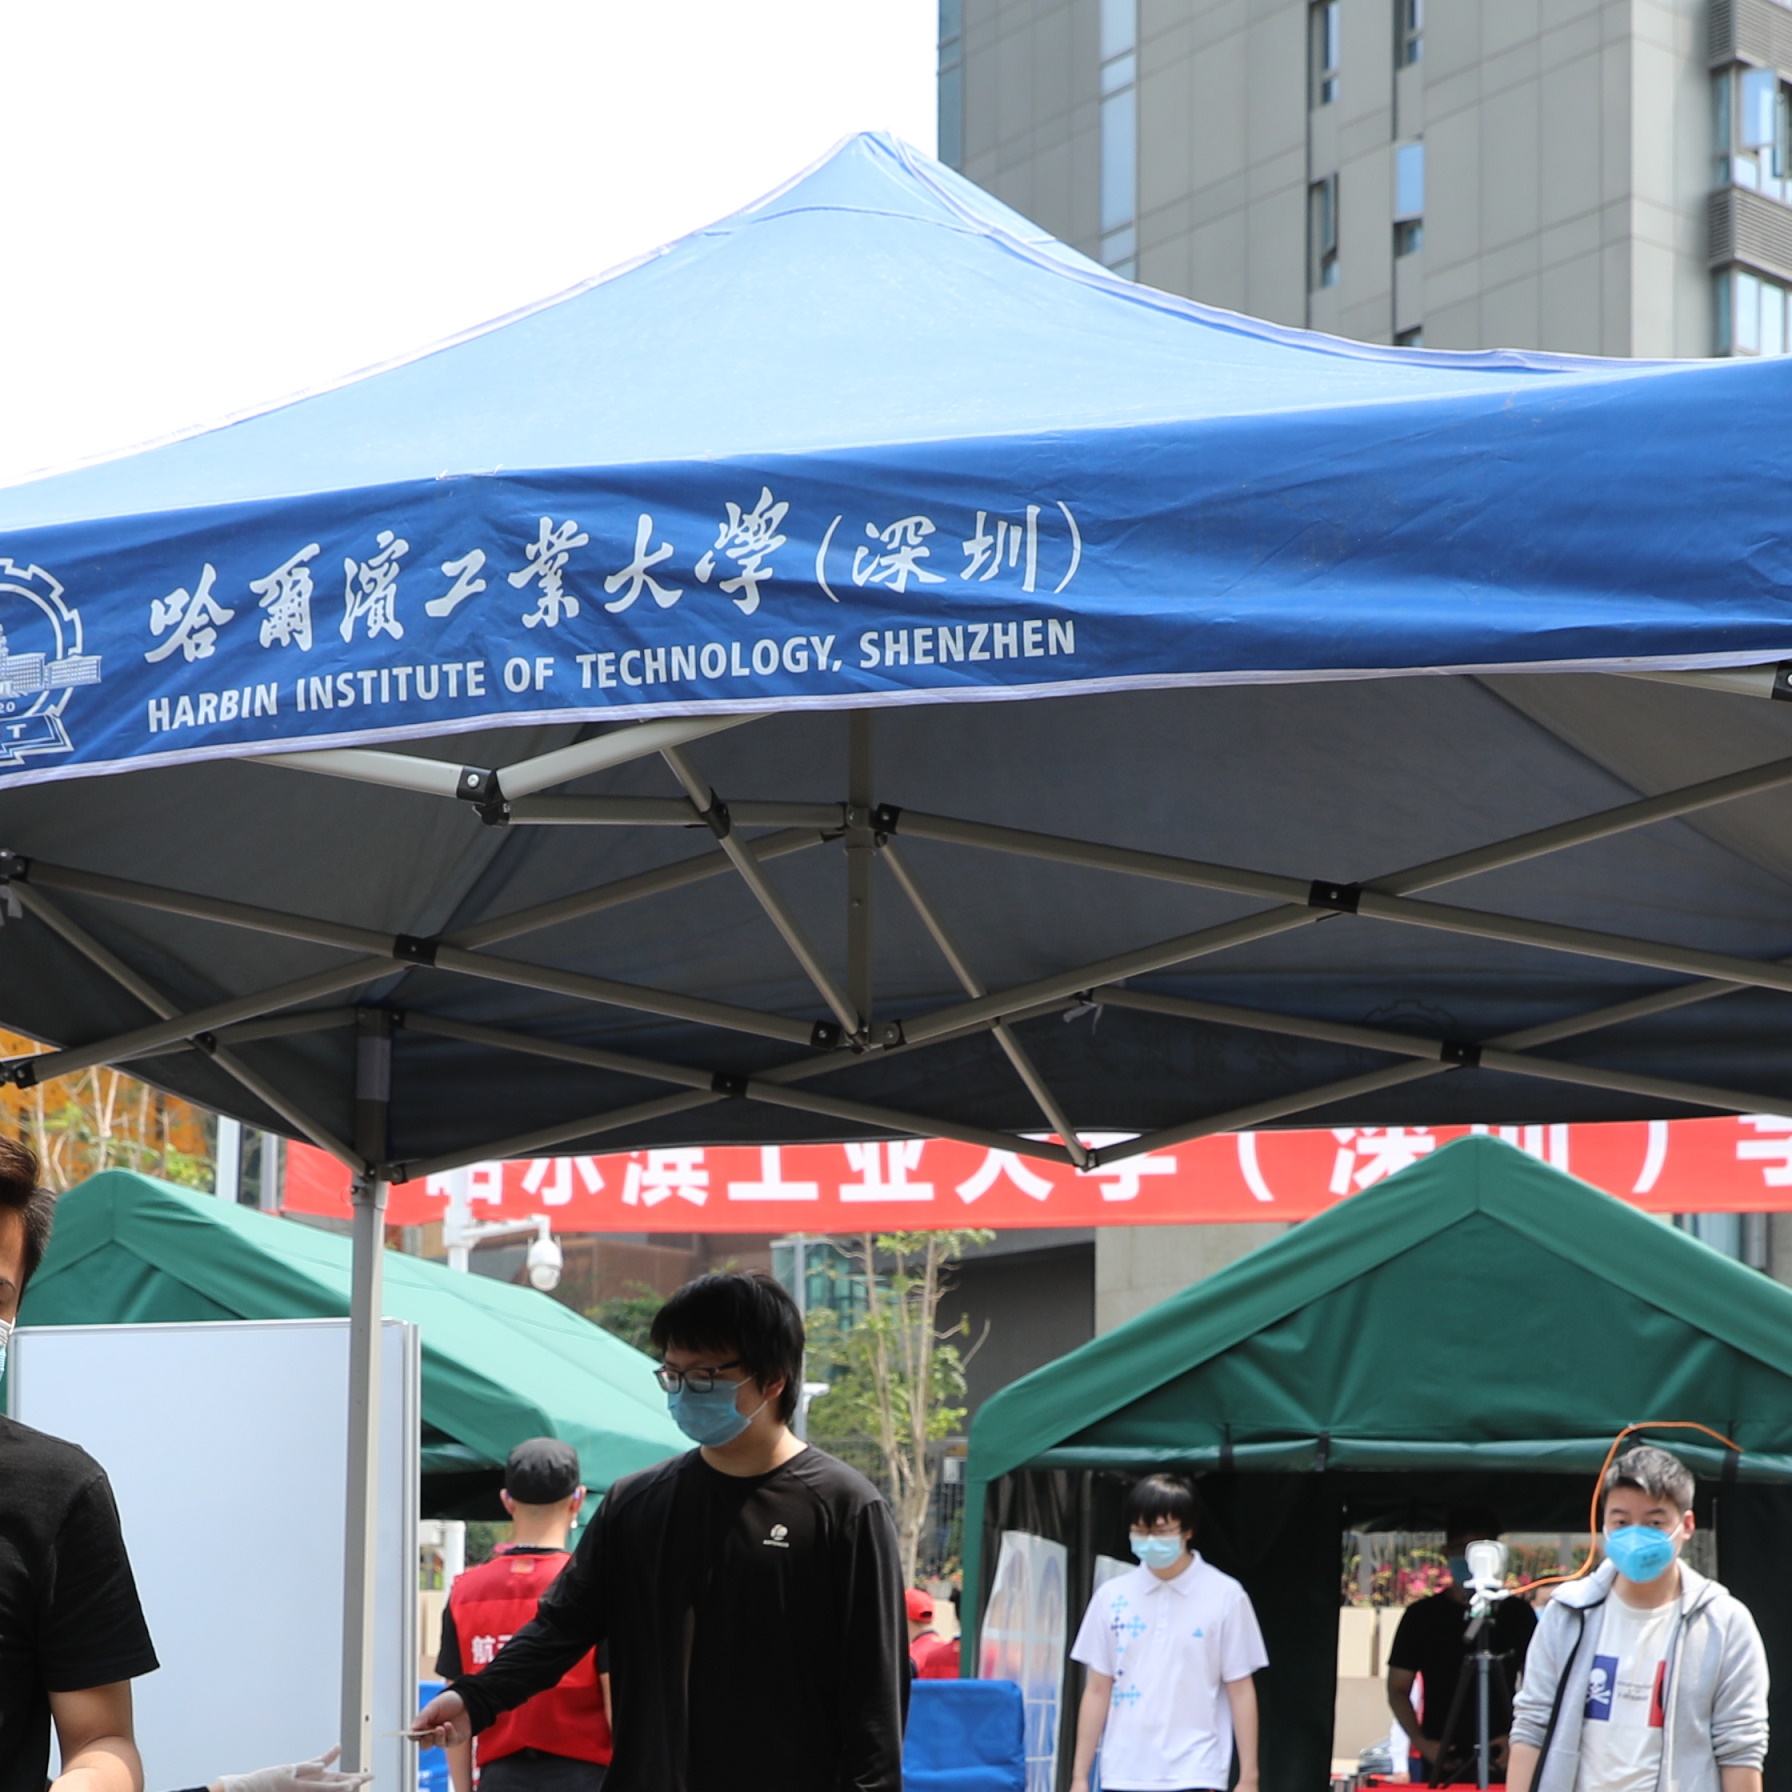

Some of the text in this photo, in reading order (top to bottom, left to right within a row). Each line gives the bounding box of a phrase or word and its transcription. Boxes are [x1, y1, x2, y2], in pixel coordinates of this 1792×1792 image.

[148, 619, 1076, 733] HARBIN INSTITUTE OF TECHNOLOGY, SHENZHEN
